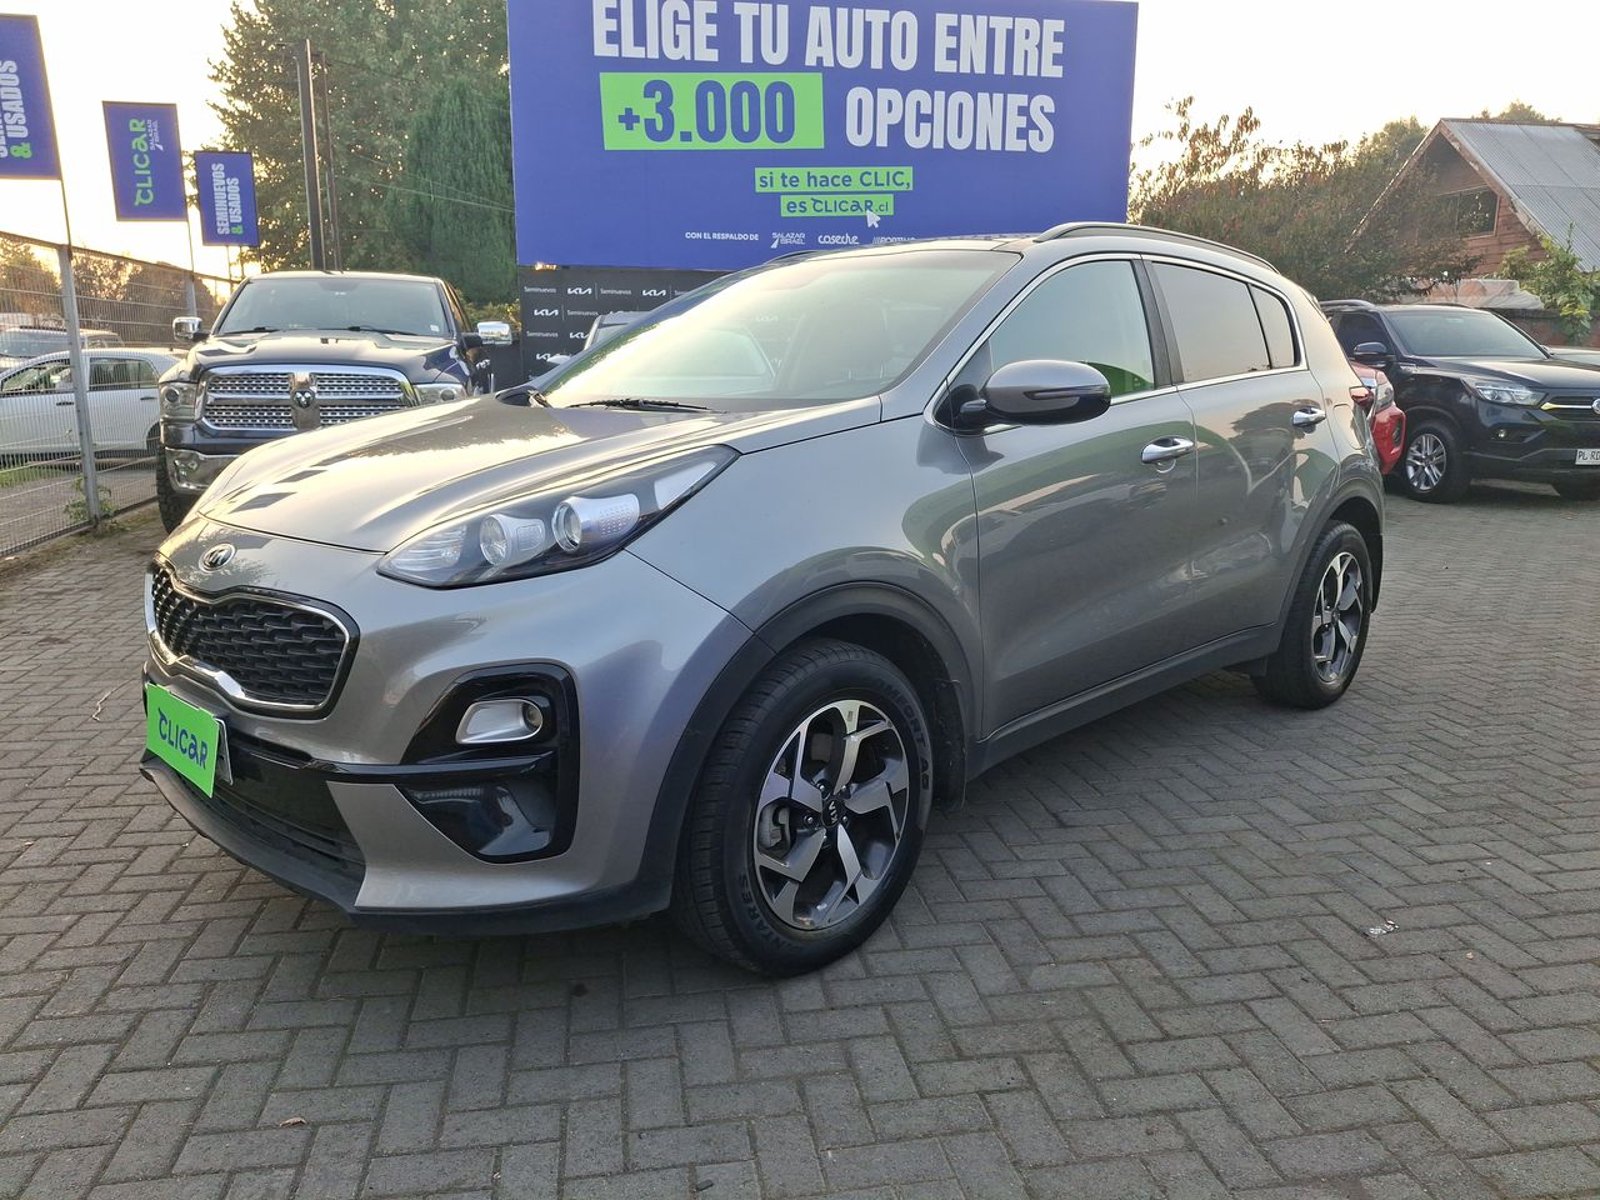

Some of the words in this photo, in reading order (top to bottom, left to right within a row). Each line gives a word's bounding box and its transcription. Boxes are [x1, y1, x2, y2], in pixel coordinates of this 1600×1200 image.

[592, 0, 719, 62] ELIGE
[733, 2, 790, 66] TU
[804, 5, 919, 72] AUTO
[934, 12, 1066, 79] ENTRE
[0, 60, 29, 138] USADOS
[617, 79, 796, 144] +3.000
[845, 86, 1056, 153] OPCIONES
[9, 142, 33, 159] &
[211, 163, 230, 235] SEMINUEVOS
[225, 177, 242, 224] USADOS
[759, 171, 774, 188] si
[780, 172, 800, 188] te
[806, 171, 853, 188] hace
[859, 171, 911, 190] CLIC,
[786, 200, 808, 213] es
[684, 231, 702, 240] CON
[703, 232, 712, 240] EL
[712, 232, 749, 241] RESPALDO
[749, 233, 760, 241] DE
